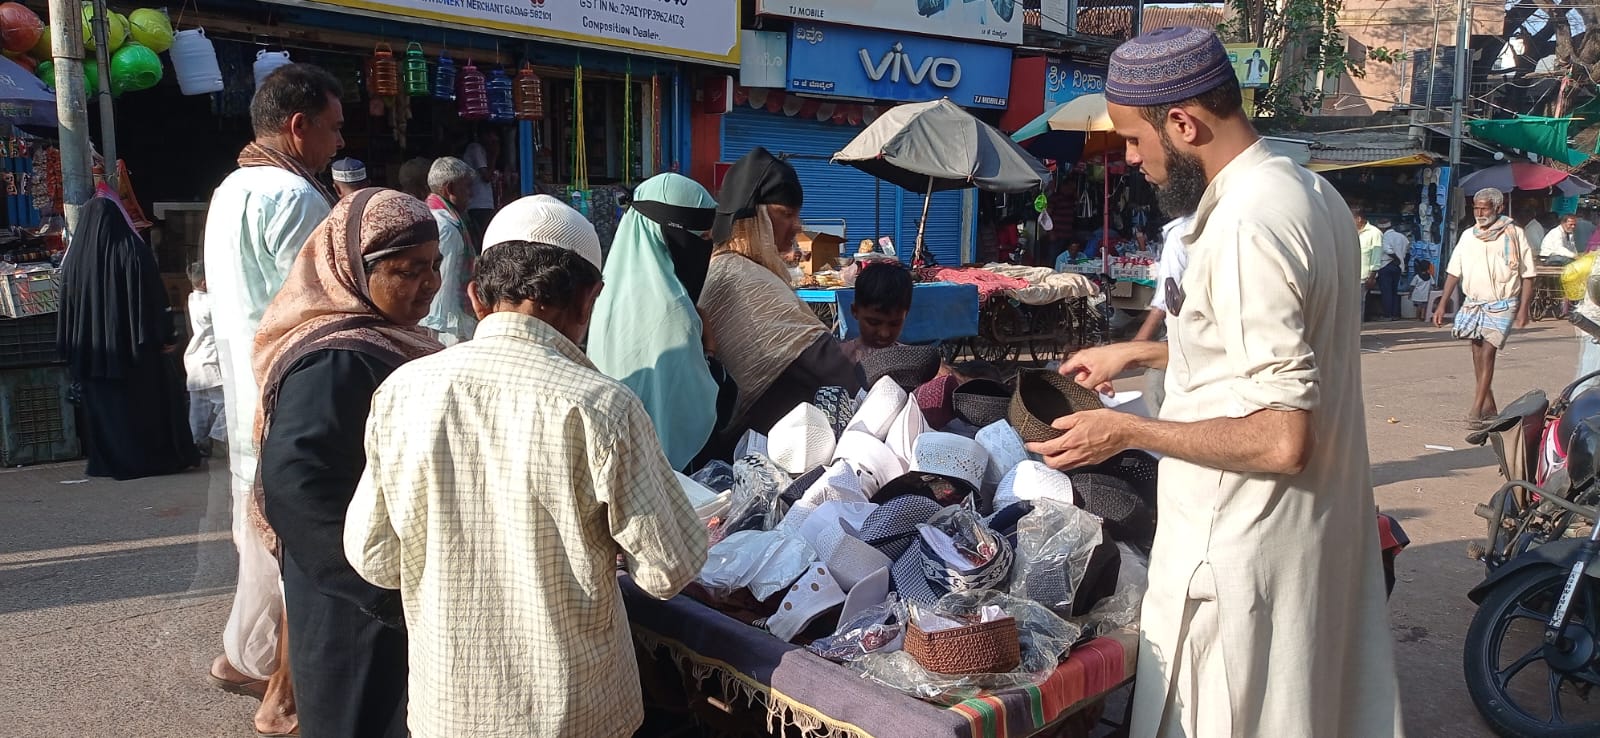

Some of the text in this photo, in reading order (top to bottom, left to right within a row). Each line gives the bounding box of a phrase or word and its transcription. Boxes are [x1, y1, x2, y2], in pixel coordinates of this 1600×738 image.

[466, 0, 504, 14] MERCHANT
[579, 0, 597, 9] GST
[789, 5, 825, 18] TJ MOBILE
[582, 15, 661, 40] Composition Dealer.
[859, 42, 961, 88] vivo
[974, 95, 982, 104] TJ
